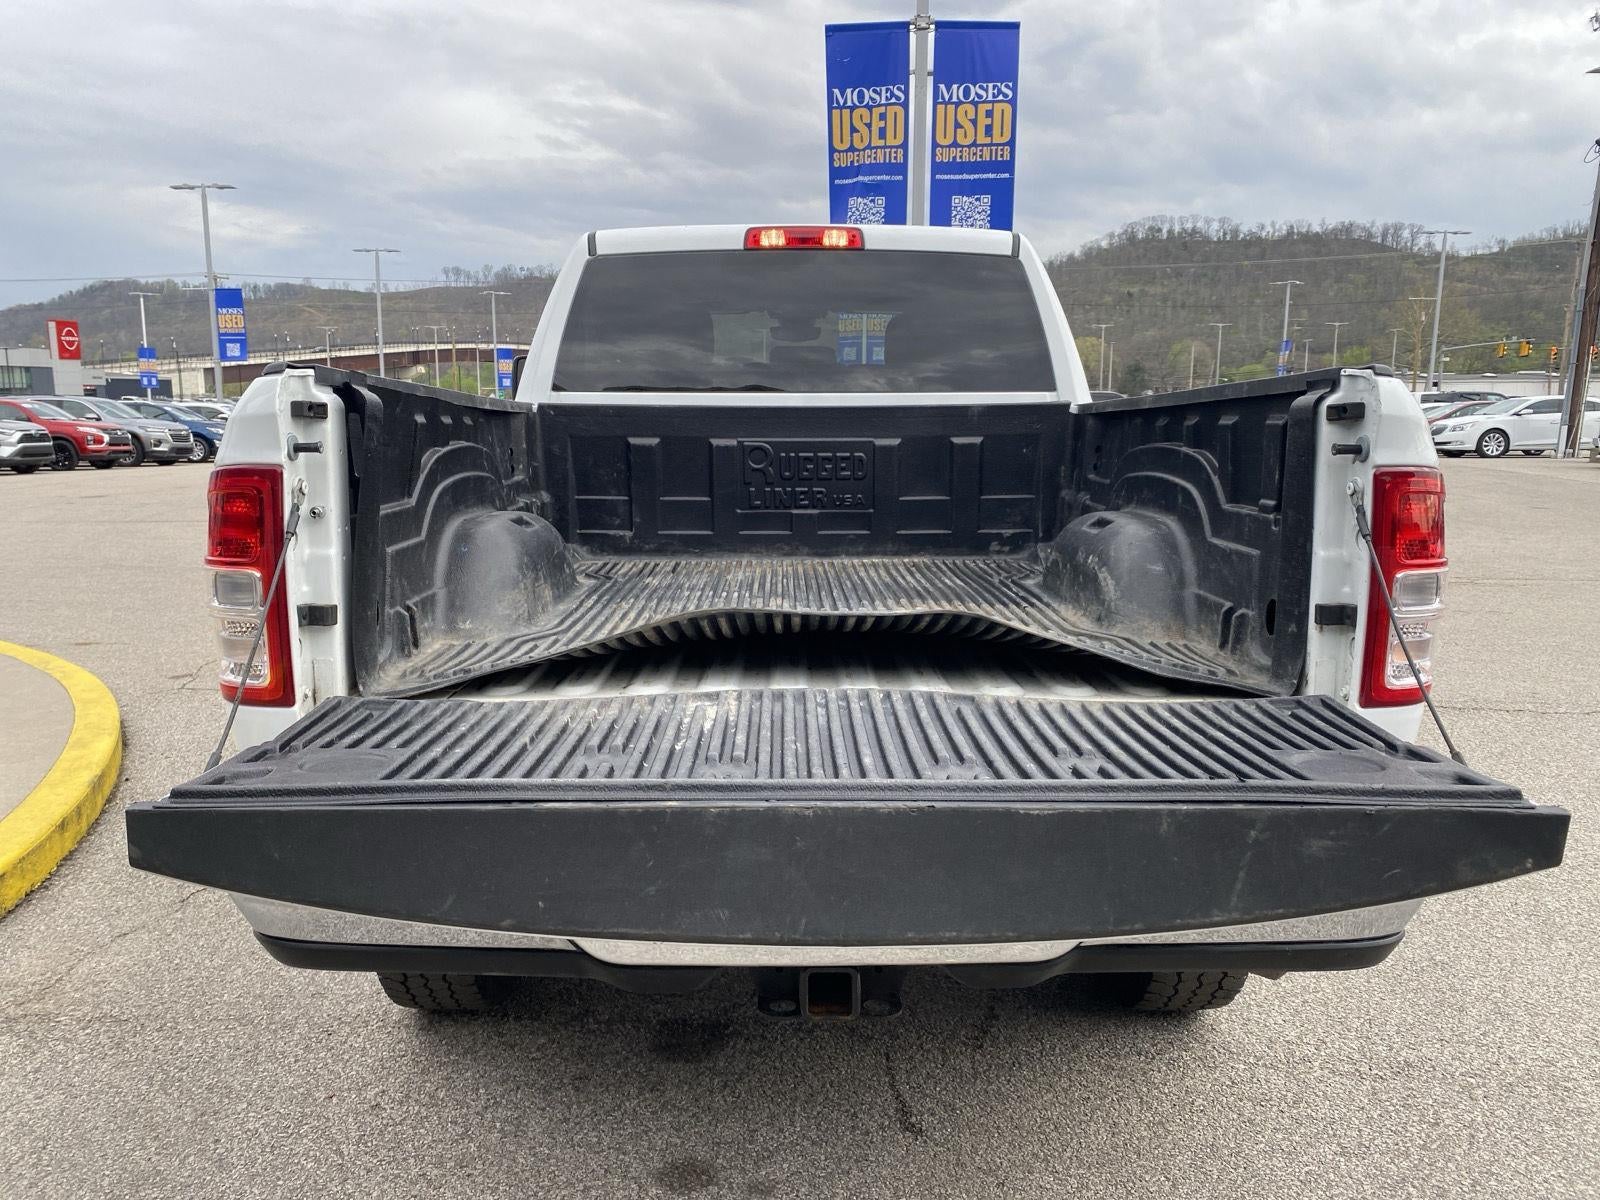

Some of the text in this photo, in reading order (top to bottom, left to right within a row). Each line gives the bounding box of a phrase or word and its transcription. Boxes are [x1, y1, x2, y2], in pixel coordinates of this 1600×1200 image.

[832, 84, 905, 107] MOSES
[937, 82, 1013, 103] MOSES
[832, 105, 905, 151] USED
[935, 102, 1012, 145] USED
[833, 148, 904, 168] SUPERCENTER
[935, 146, 1010, 163] SUPERCENTER
[834, 174, 903, 185] mosesusedsupercenter.com
[935, 172, 1010, 180] mosesusedsupercenter.com
[218, 314, 244, 328] USED
[743, 441, 867, 485] RUGGED
[749, 487, 827, 509] LINER
